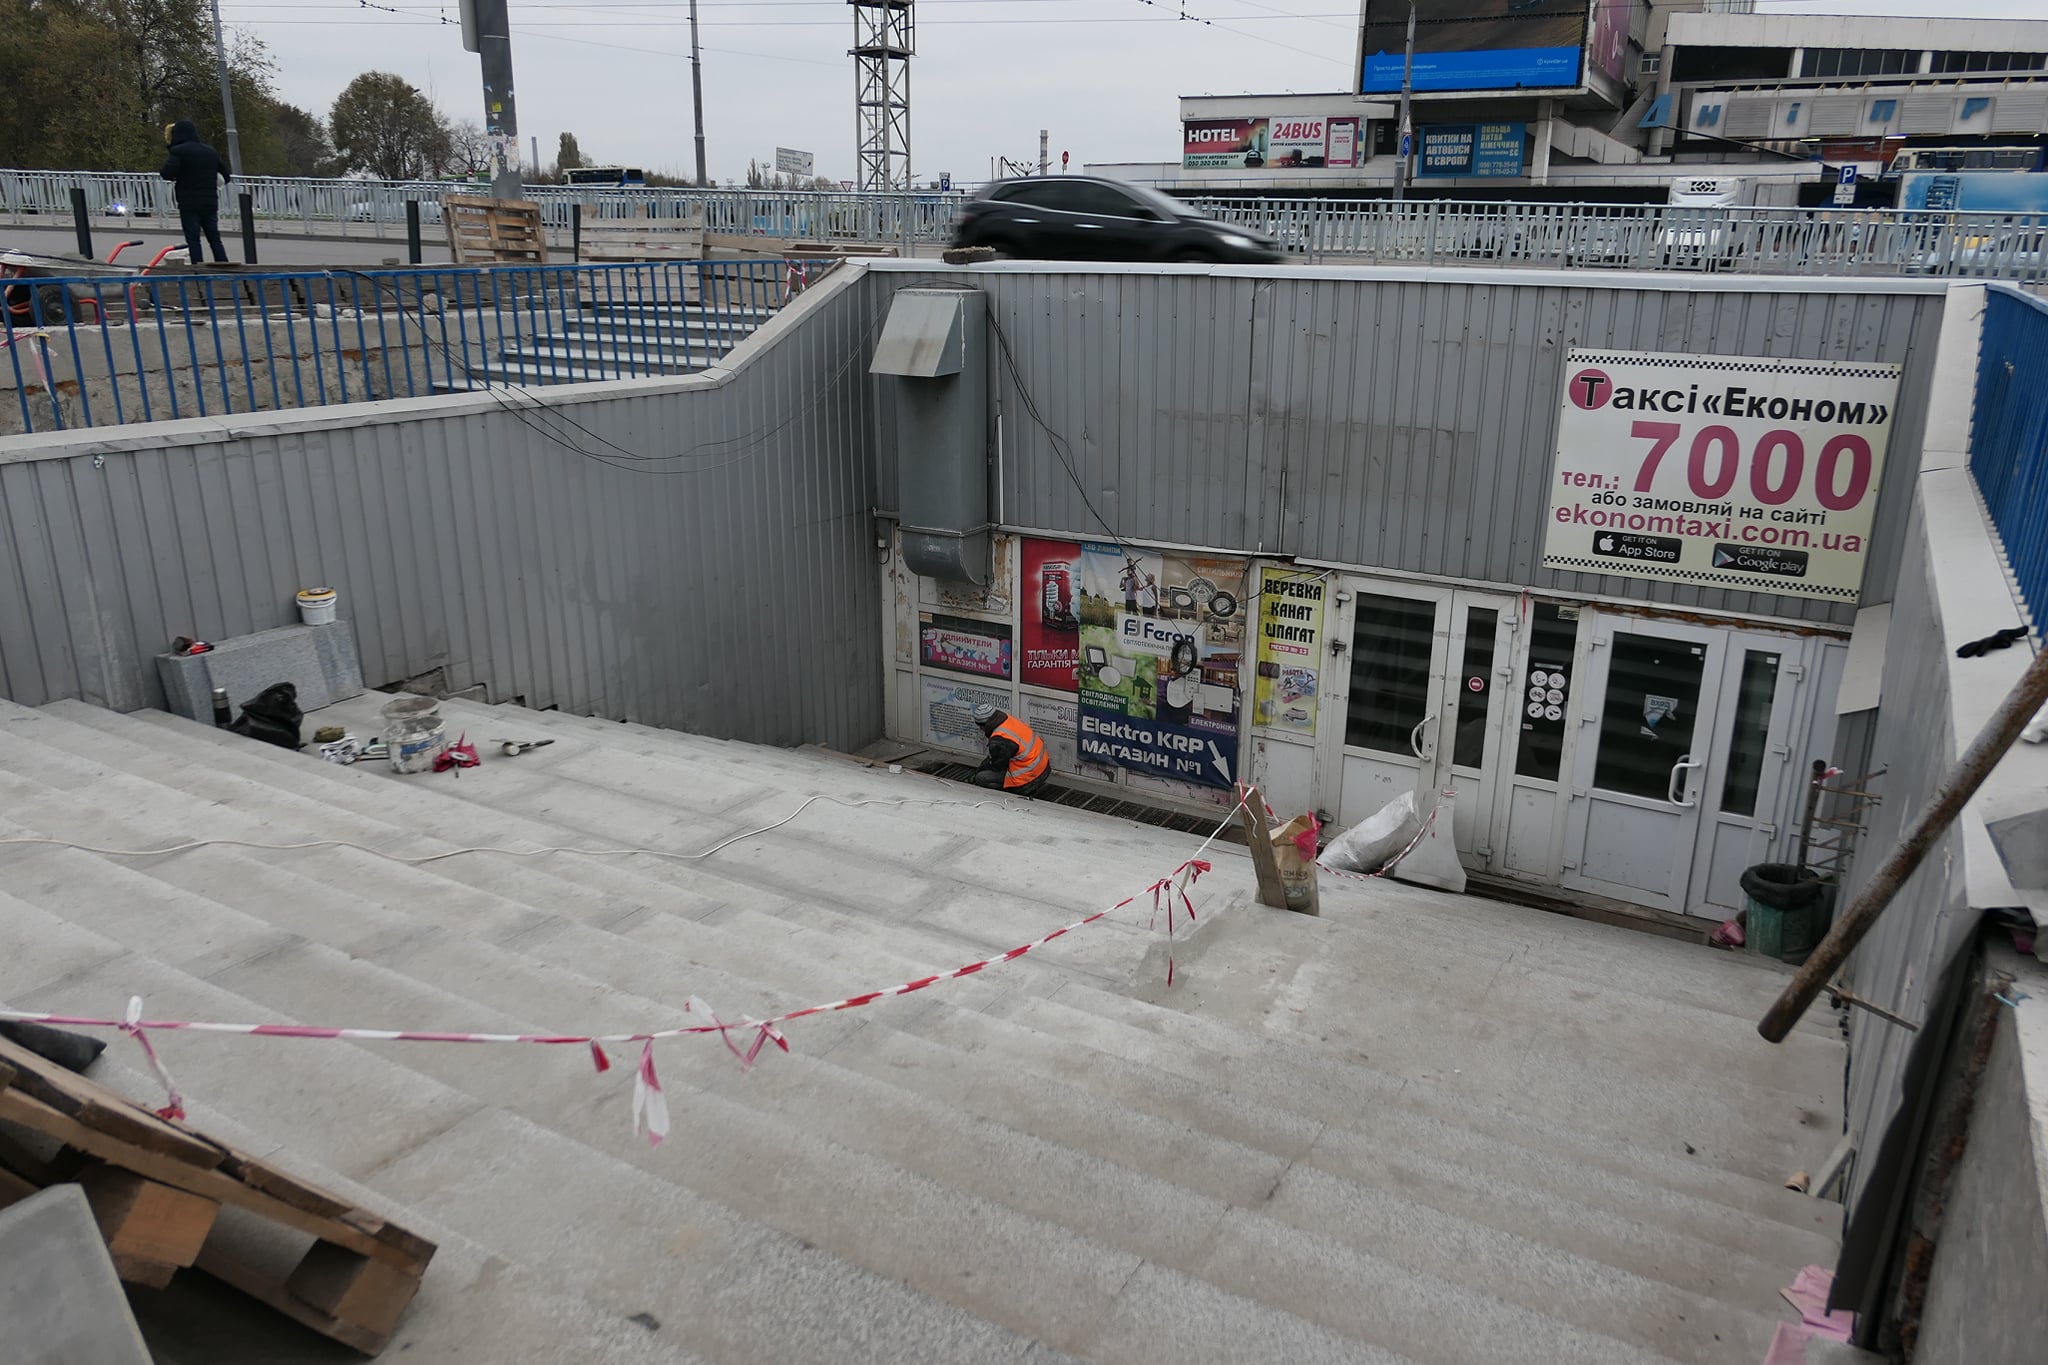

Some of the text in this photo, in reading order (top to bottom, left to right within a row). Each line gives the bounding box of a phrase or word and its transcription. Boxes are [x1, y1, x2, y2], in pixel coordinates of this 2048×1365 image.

[1188, 128, 1240, 143] HOTEL
[1273, 122, 1322, 140] 24BUS
[1426, 133, 1472, 144] КВИТКИ НА
[1426, 145, 1470, 155] АВТОБУСИ
[1427, 156, 1468, 166] В ЄВРОПУ
[1842, 168, 1854, 183] P
[1631, 420, 1872, 511] 7000
[1561, 471, 1620, 490] тел.:
[1591, 491, 1826, 526] або замовляй на сайті
[1555, 503, 1861, 553] ekonomtaxi.com.ua
[1622, 535, 1637, 543] GET
[1619, 544, 1675, 560] App Store
[1739, 546, 1755, 554] GET
[1766, 549, 1781, 557] ON
[1737, 556, 1805, 573] Google play
[1264, 579, 1322, 600] ВЕРЕВКА
[1271, 602, 1313, 621] КАНАТ
[1143, 621, 1196, 644] Feron
[1265, 622, 1316, 644] ШПАГАТ
[941, 655, 977, 669] МАГАЗИН
[1027, 659, 1071, 668] ГАРАНТІЯ
[955, 687, 1010, 709] САНТЕХНИК
[1081, 689, 1127, 704] СВІТЛОДІОДНЕ
[1081, 697, 1120, 711] ОСВІТЛЕННЯ
[1191, 718, 1237, 733] ЕЛЕКТРОНІКА
[1081, 715, 1153, 744] Elektro
[1157, 730, 1204, 754] KRP
[1081, 738, 1201, 775] МАГАЗИН №1
